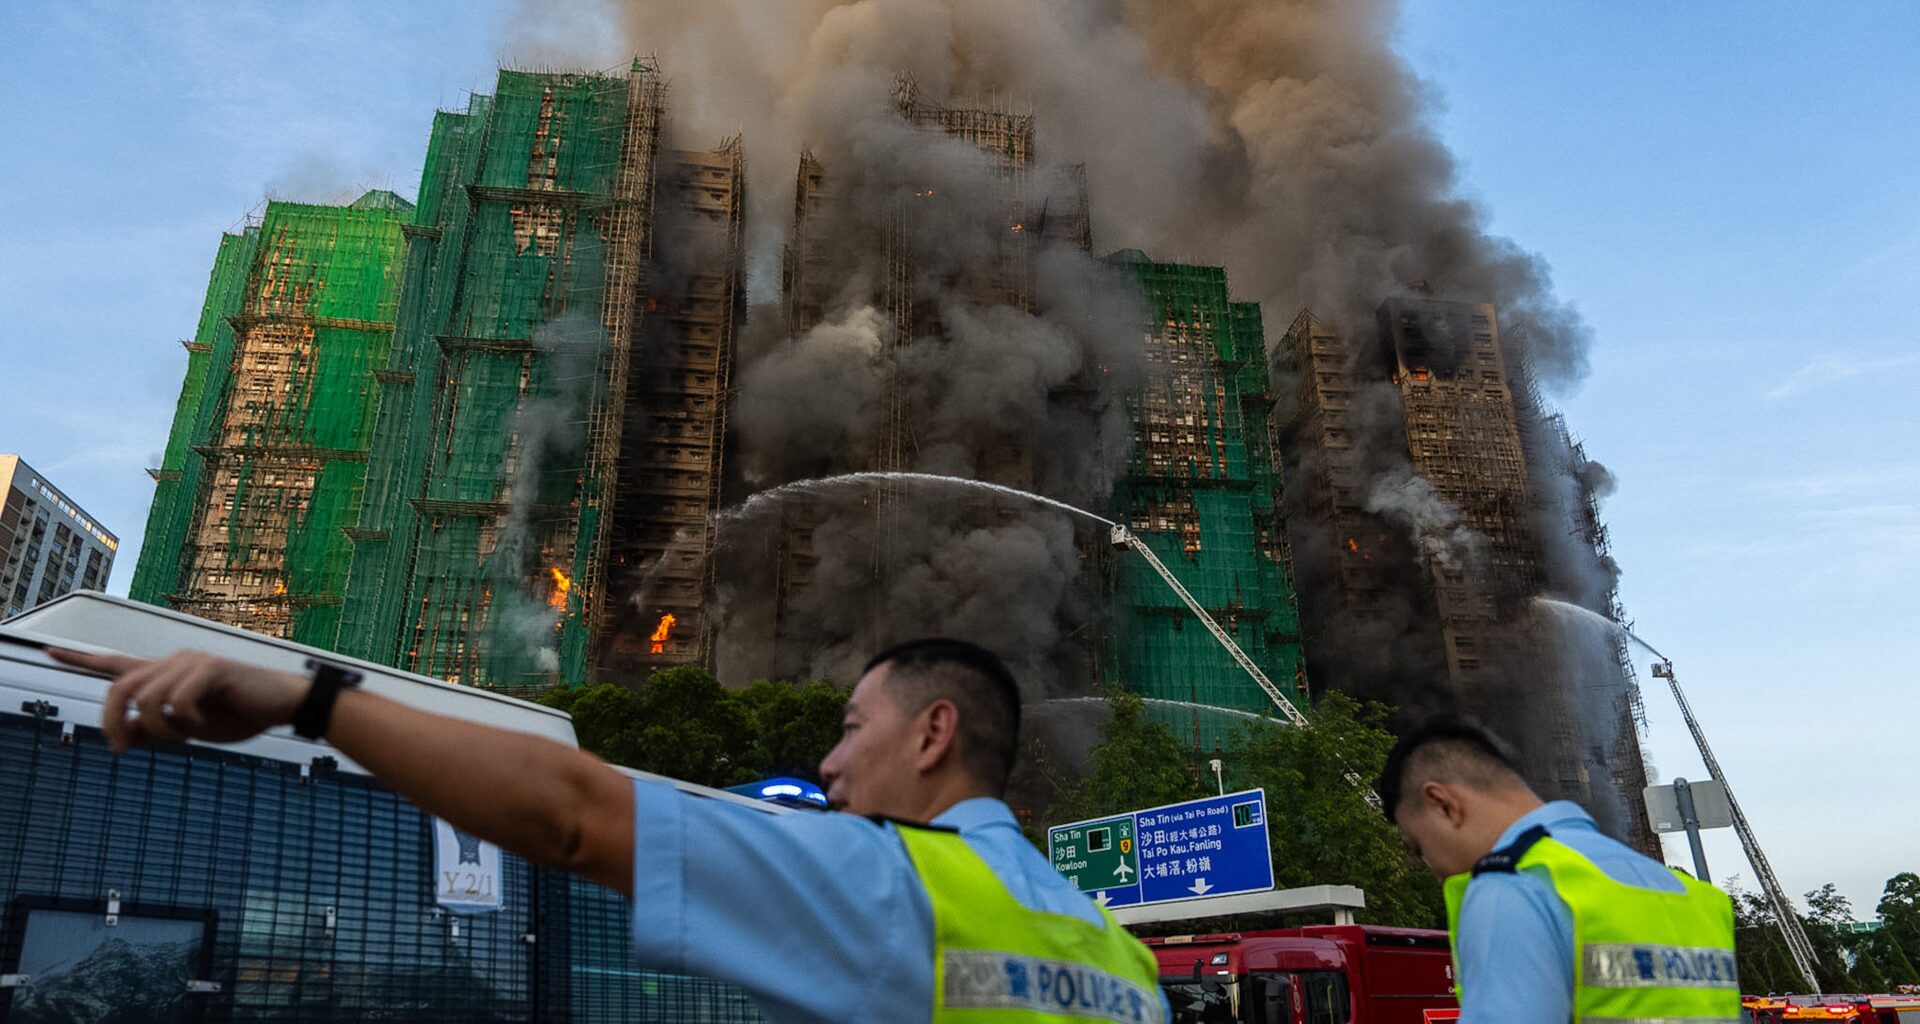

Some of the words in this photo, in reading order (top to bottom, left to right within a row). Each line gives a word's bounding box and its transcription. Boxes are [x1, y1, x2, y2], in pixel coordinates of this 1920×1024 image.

[1139, 817, 1155, 827] Sha
[1157, 813, 1170, 824] Tin
[1171, 815, 1183, 823] (via
[1185, 811, 1195, 819] Tai
[1196, 809, 1206, 817] Po
[1207, 805, 1229, 815] Road)
[1236, 805, 1251, 826] 10
[1054, 833, 1069, 842] Sha
[1069, 830, 1081, 839] Tin
[1055, 845, 1076, 861] 沙田
[1122, 841, 1129, 851] 9
[1142, 848, 1155, 858] Tai
[1156, 847, 1168, 857] Po
[1056, 861, 1087, 872] Kowloon
[444, 871, 461, 894] Y
[1037, 963, 1125, 1015] POLICE
